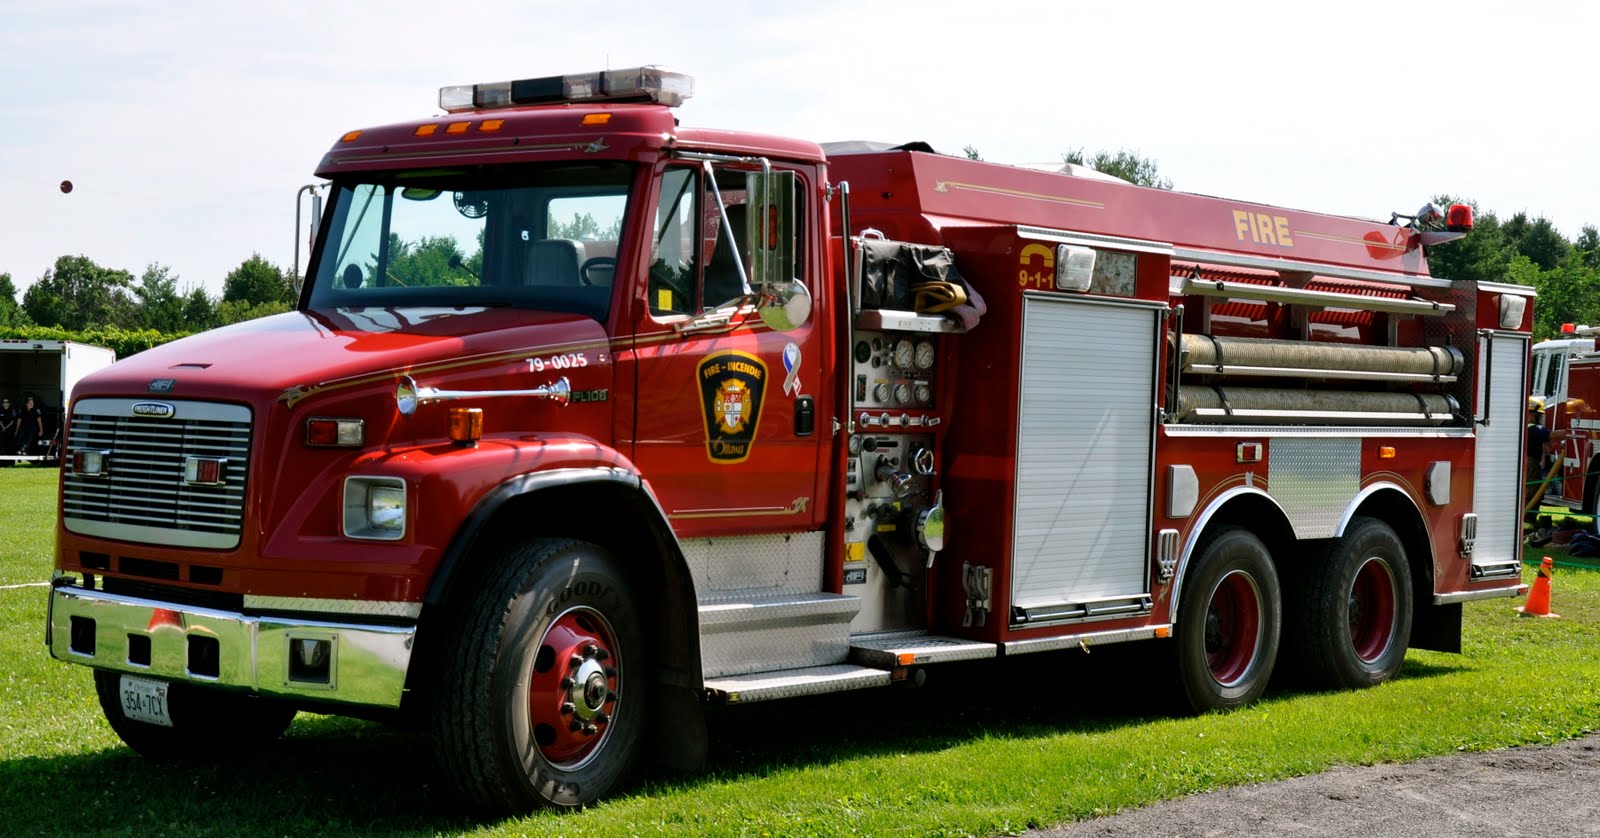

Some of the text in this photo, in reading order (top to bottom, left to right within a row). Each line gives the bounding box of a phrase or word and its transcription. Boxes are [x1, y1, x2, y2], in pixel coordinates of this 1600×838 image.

[1232, 209, 1293, 247] FIRE
[1019, 270, 1054, 289] 9-1-1
[525, 353, 588, 373] 79-0025
[703, 363, 721, 379] FIRE
[727, 361, 763, 380] INCENDIE
[134, 405, 168, 415] FREIGHTLINER
[712, 435, 745, 456] Ottawa
